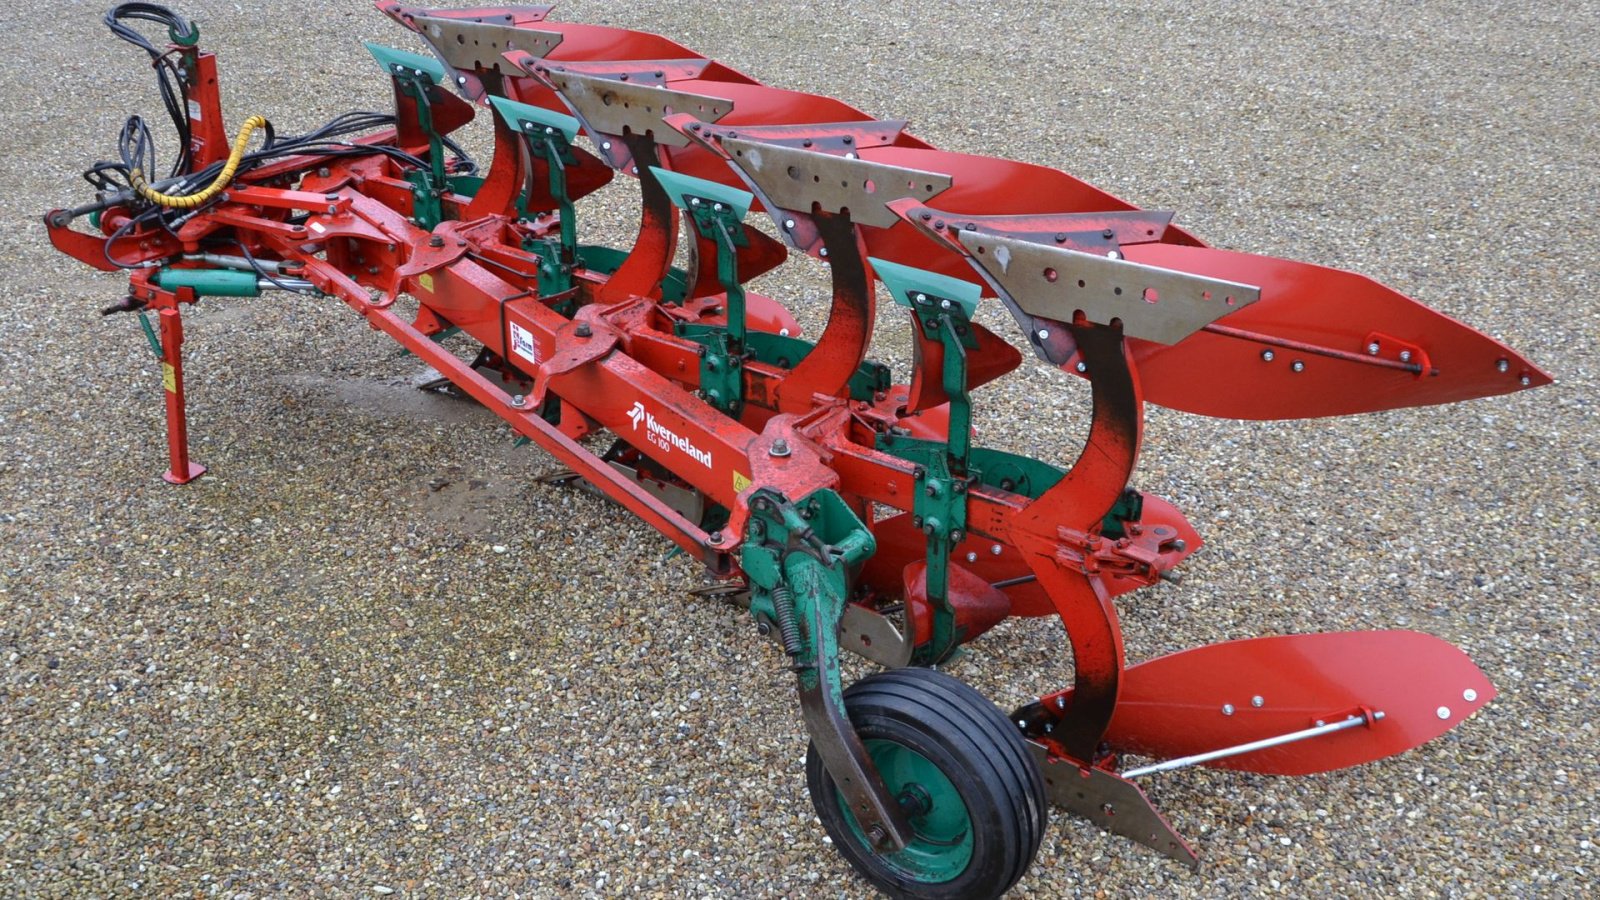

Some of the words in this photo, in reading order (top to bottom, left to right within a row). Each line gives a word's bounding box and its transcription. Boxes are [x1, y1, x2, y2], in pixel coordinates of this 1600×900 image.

[647, 413, 712, 469] Kverneland
[647, 430, 657, 444] EG
[658, 437, 670, 453] 100
